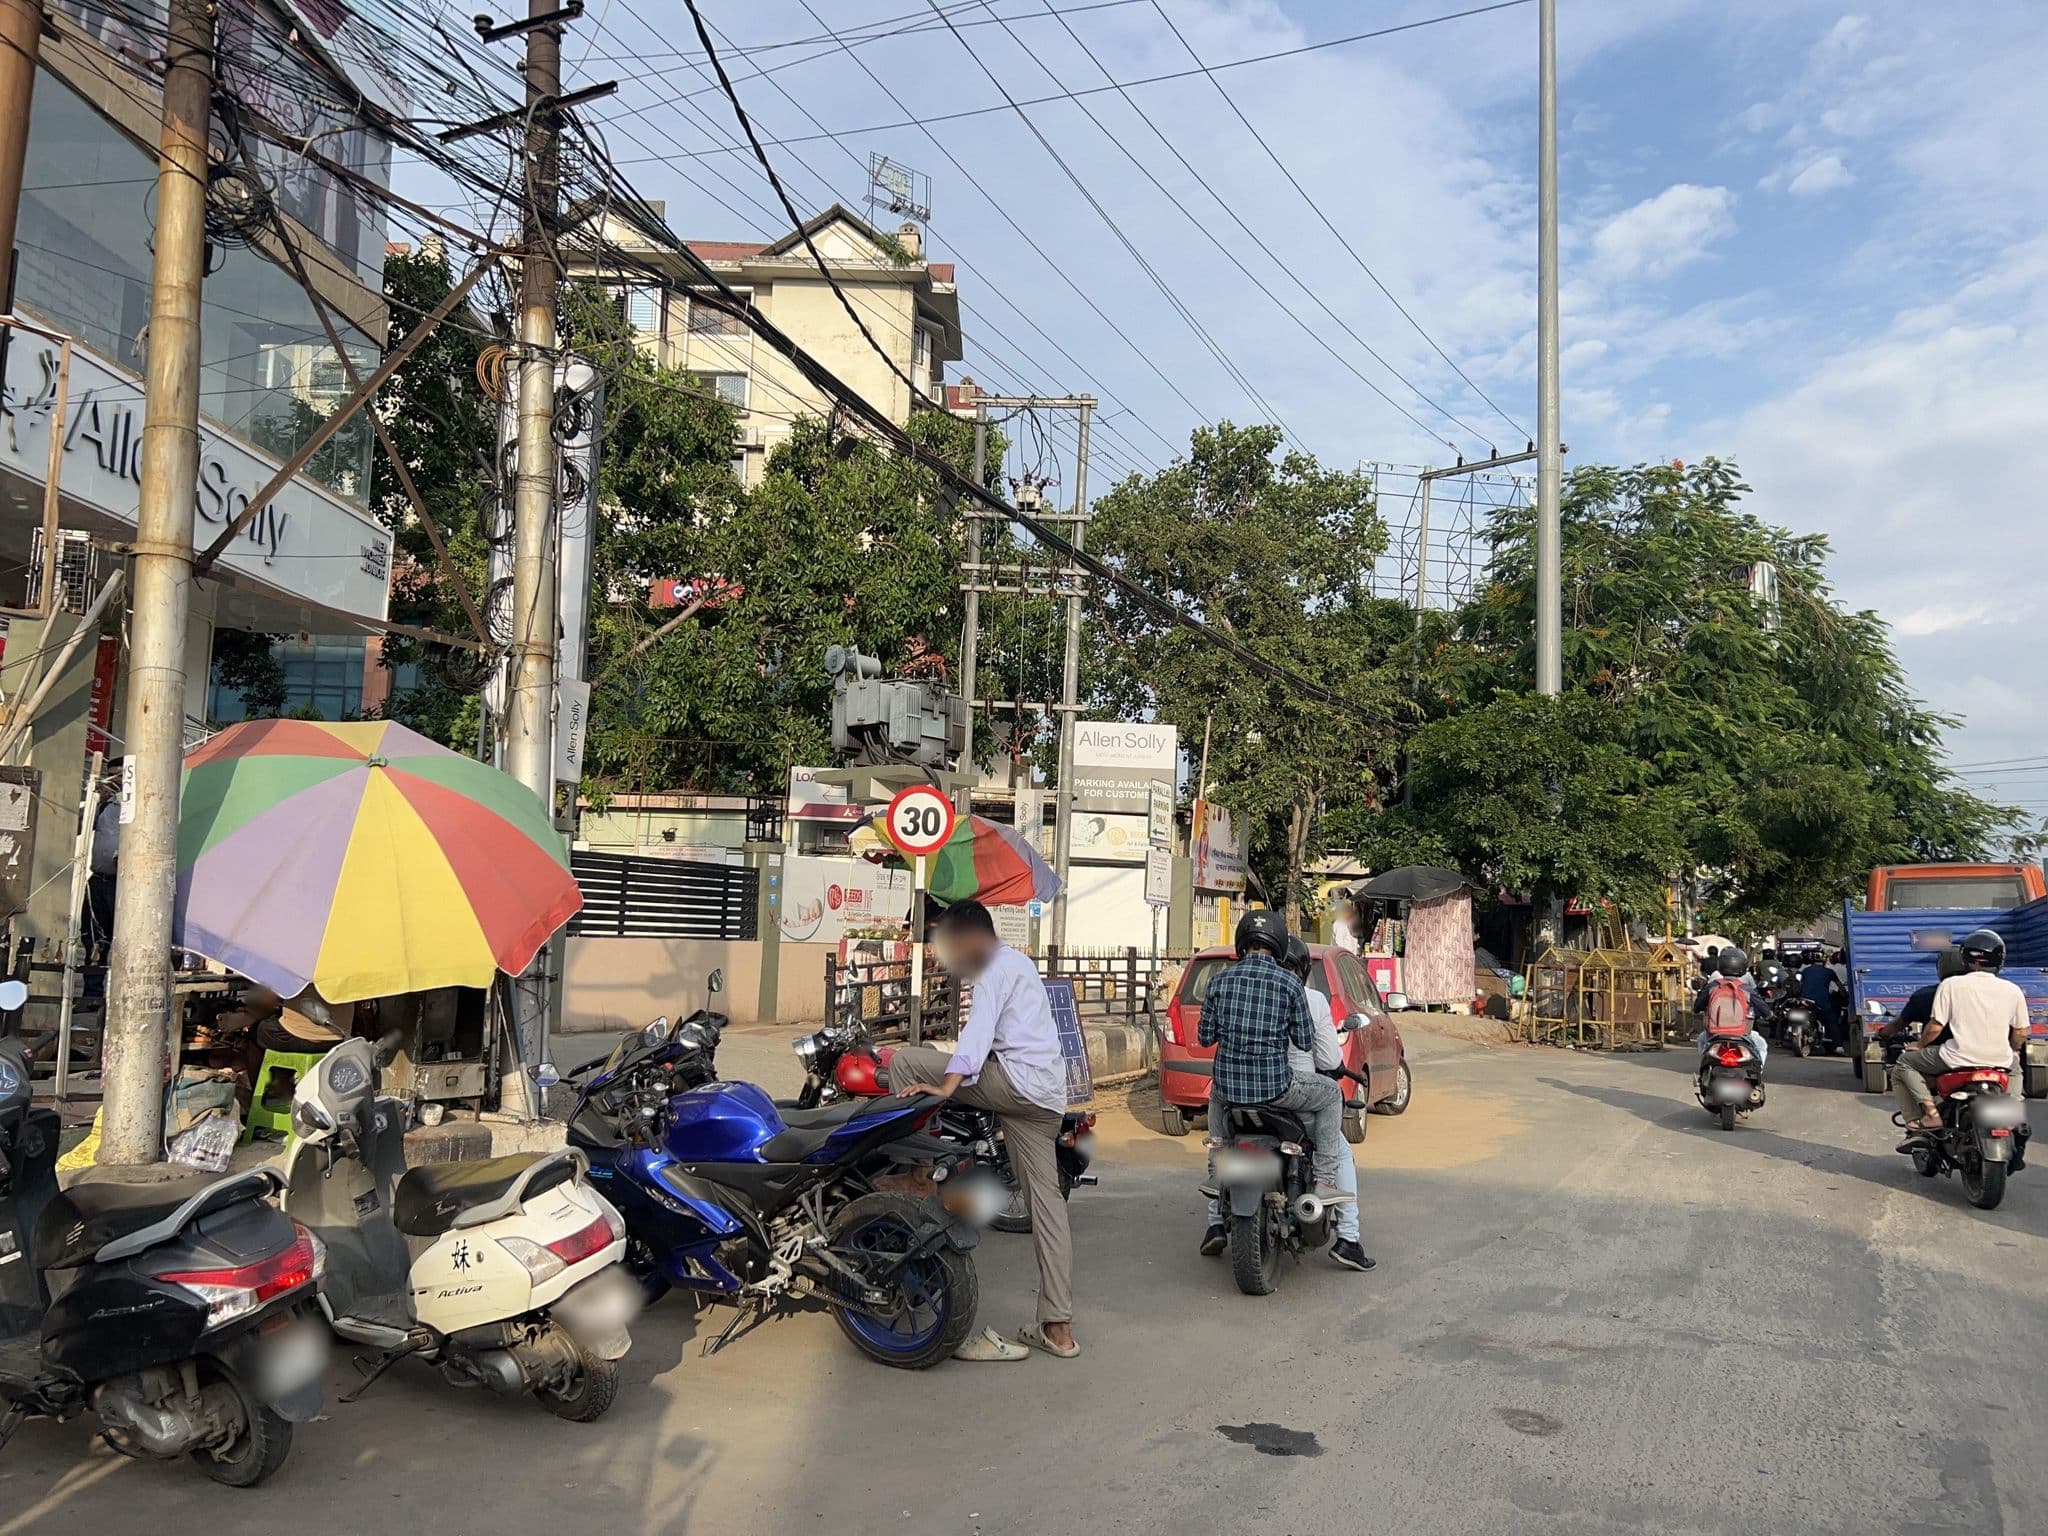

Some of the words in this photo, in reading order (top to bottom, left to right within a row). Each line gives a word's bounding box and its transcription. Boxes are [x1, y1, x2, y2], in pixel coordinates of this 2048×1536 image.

[570, 700, 583, 730] Solly
[566, 733, 578, 764] Allen
[1078, 731, 1121, 748] Allen
[1124, 732, 1167, 753] Solly
[1074, 778, 1115, 788] PARKING
[1117, 780, 1152, 790] AVAILA
[1083, 788, 1104, 798] FOR
[901, 807, 941, 836] 30
[1019, 802, 1029, 821] Solly
[437, 1285, 483, 1299] Activa
